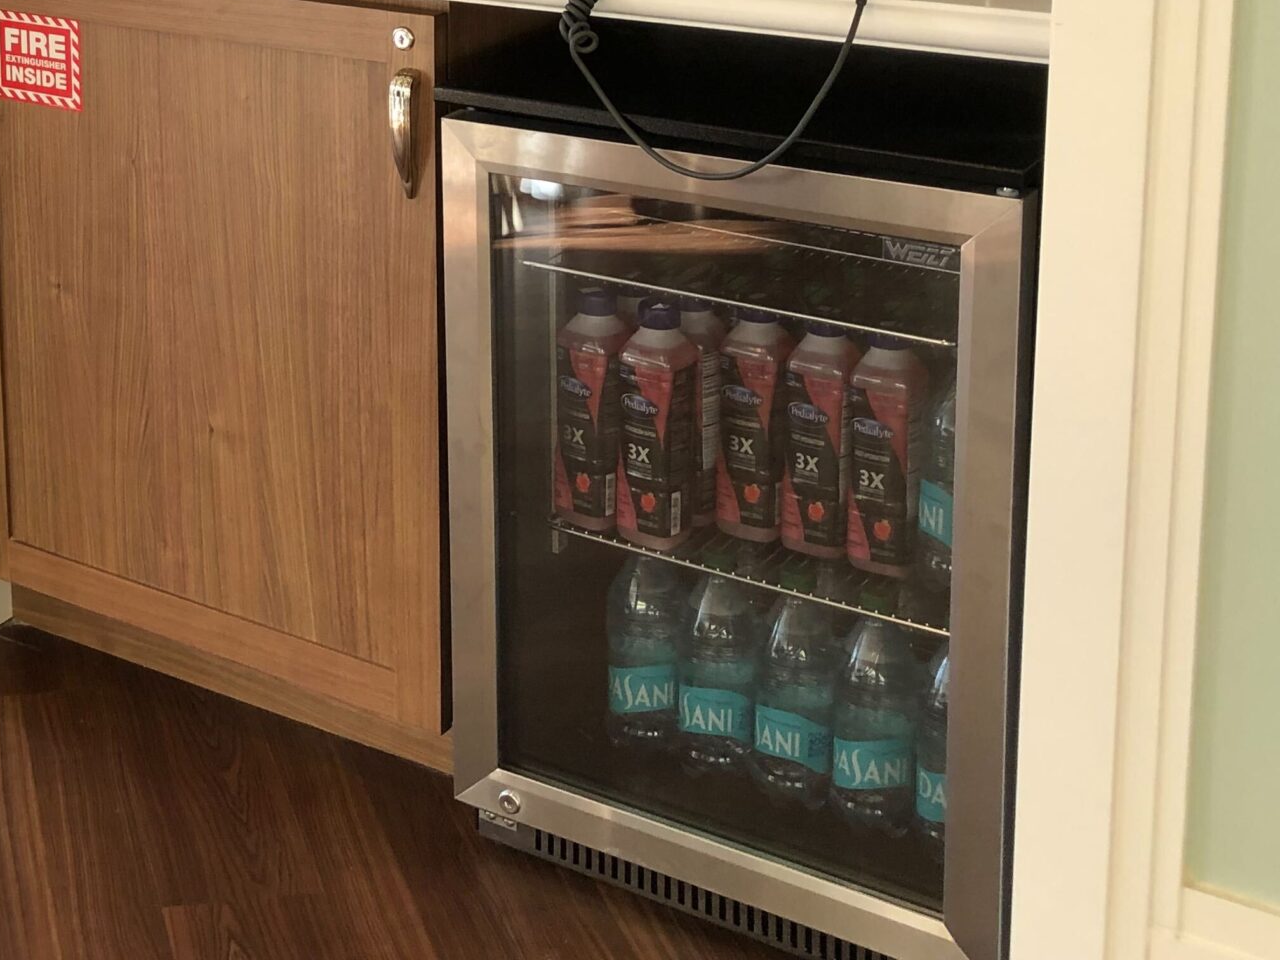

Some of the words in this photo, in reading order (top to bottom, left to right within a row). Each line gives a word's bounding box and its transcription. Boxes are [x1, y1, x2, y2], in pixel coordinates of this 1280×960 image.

[4, 27, 66, 60] FIRE
[5, 54, 66, 71] EXTINGUISHER
[6, 64, 67, 90] INSIDE
[624, 398, 658, 415] Pedialyte
[725, 389, 762, 407] Pedialyte
[791, 406, 828, 425] Pedialyte
[564, 424, 584, 445] 3X
[854, 421, 893, 439] Pedialyte
[628, 442, 650, 464] 3X
[729, 435, 753, 455] 3X
[795, 452, 818, 473] 3X
[859, 469, 885, 490] 3X
[609, 673, 674, 710] ASANI
[835, 748, 907, 786] ASANI
